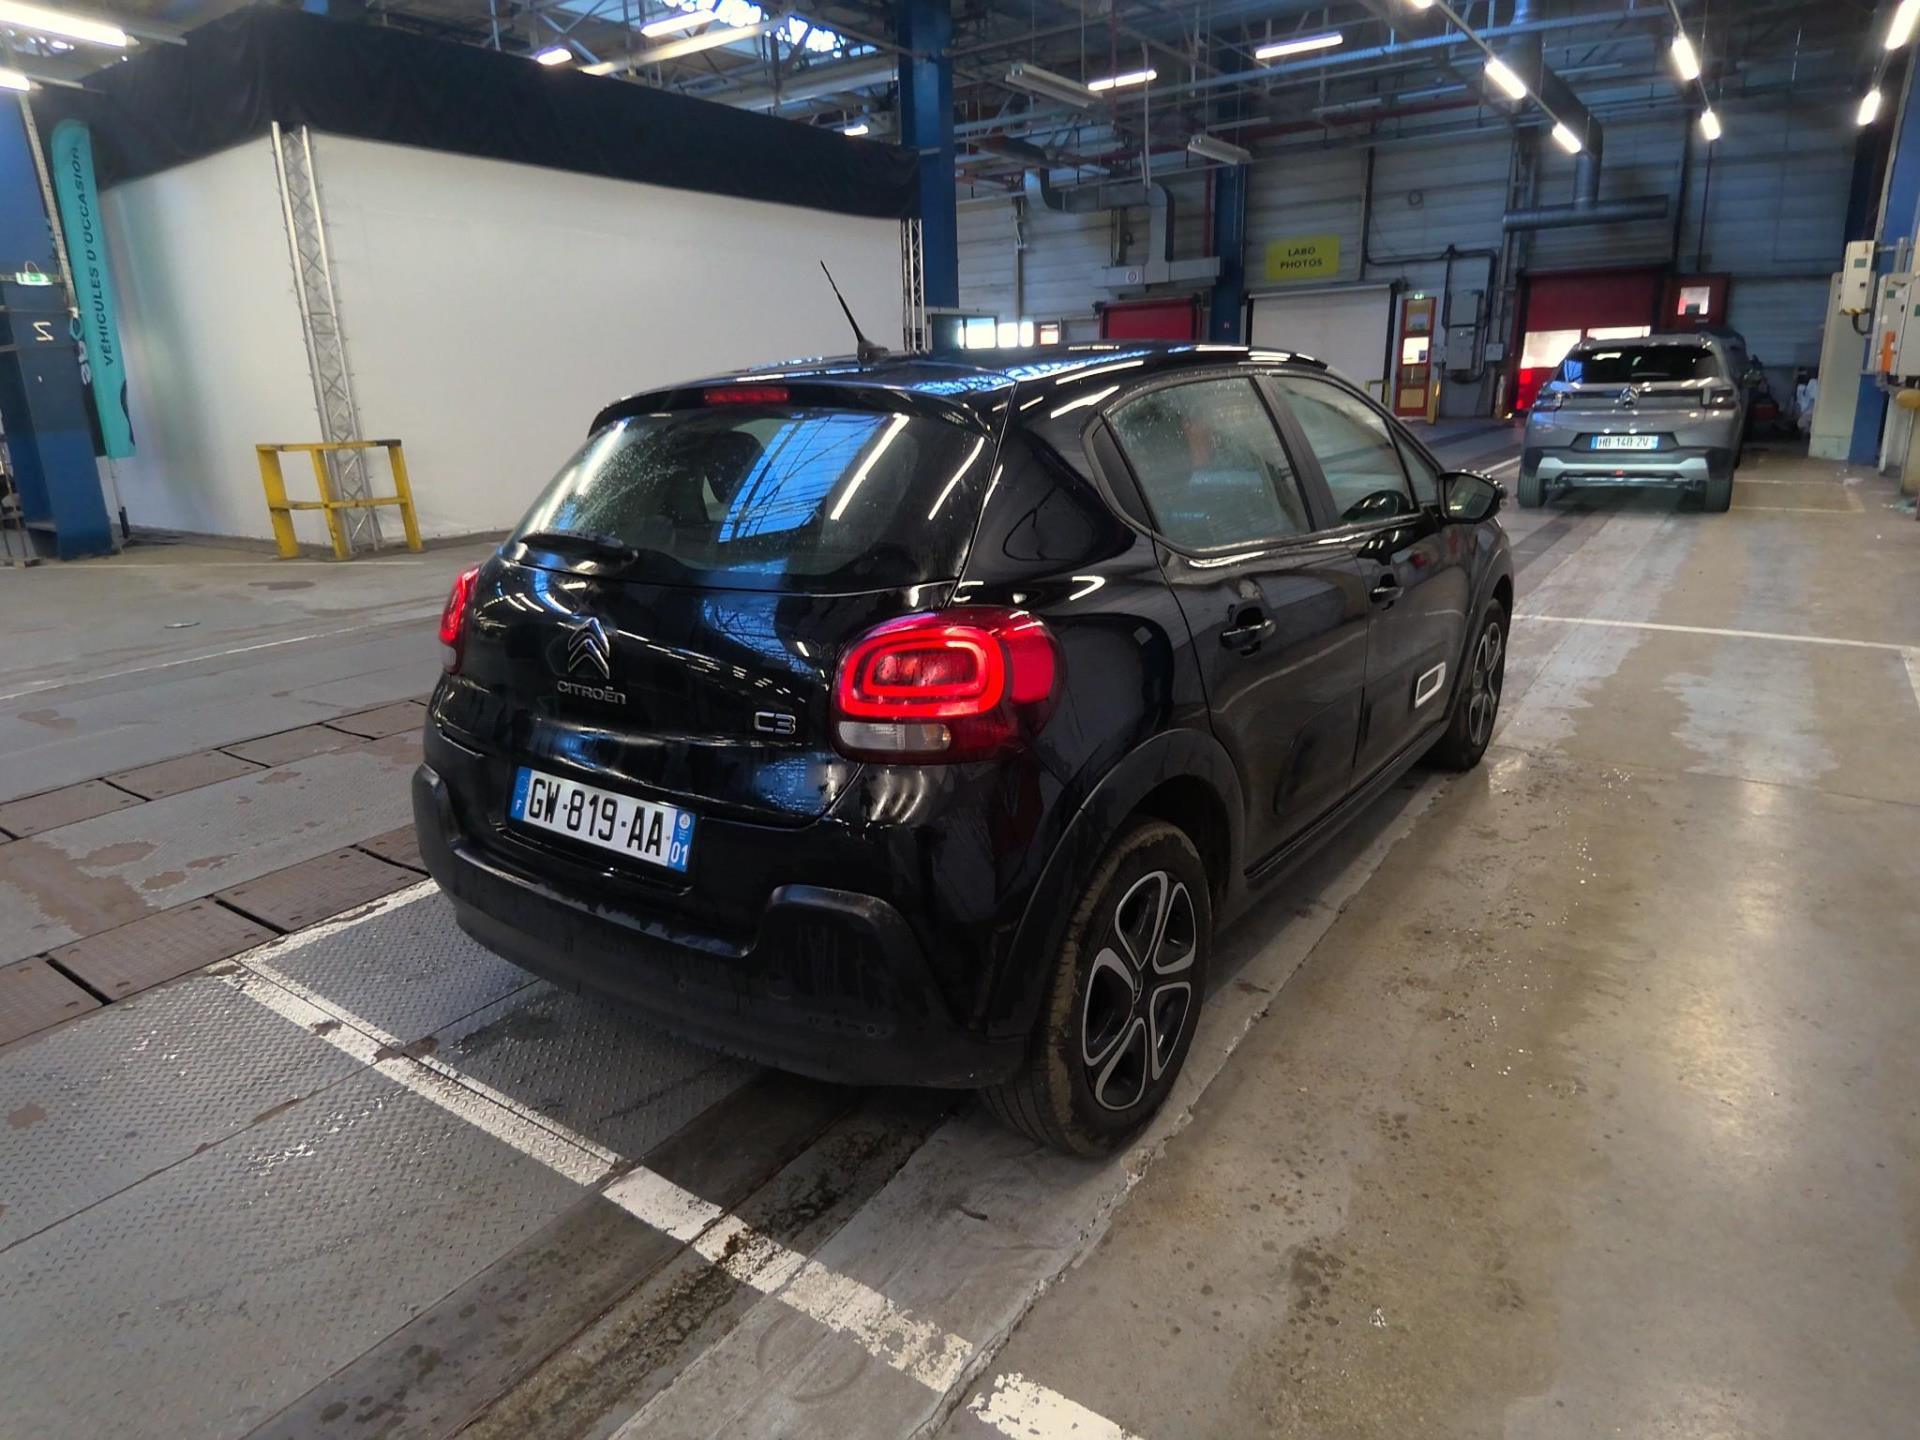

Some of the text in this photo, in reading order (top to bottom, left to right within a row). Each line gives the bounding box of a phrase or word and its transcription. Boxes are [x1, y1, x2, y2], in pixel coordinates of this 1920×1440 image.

[1287, 246, 1316, 257] LABO
[1280, 258, 1323, 270] PHOTOS
[88, 268, 114, 367] VÉHICULES
[754, 711, 796, 735] C3
[528, 777, 665, 857] GW-819-AA
[670, 841, 689, 866] 01
